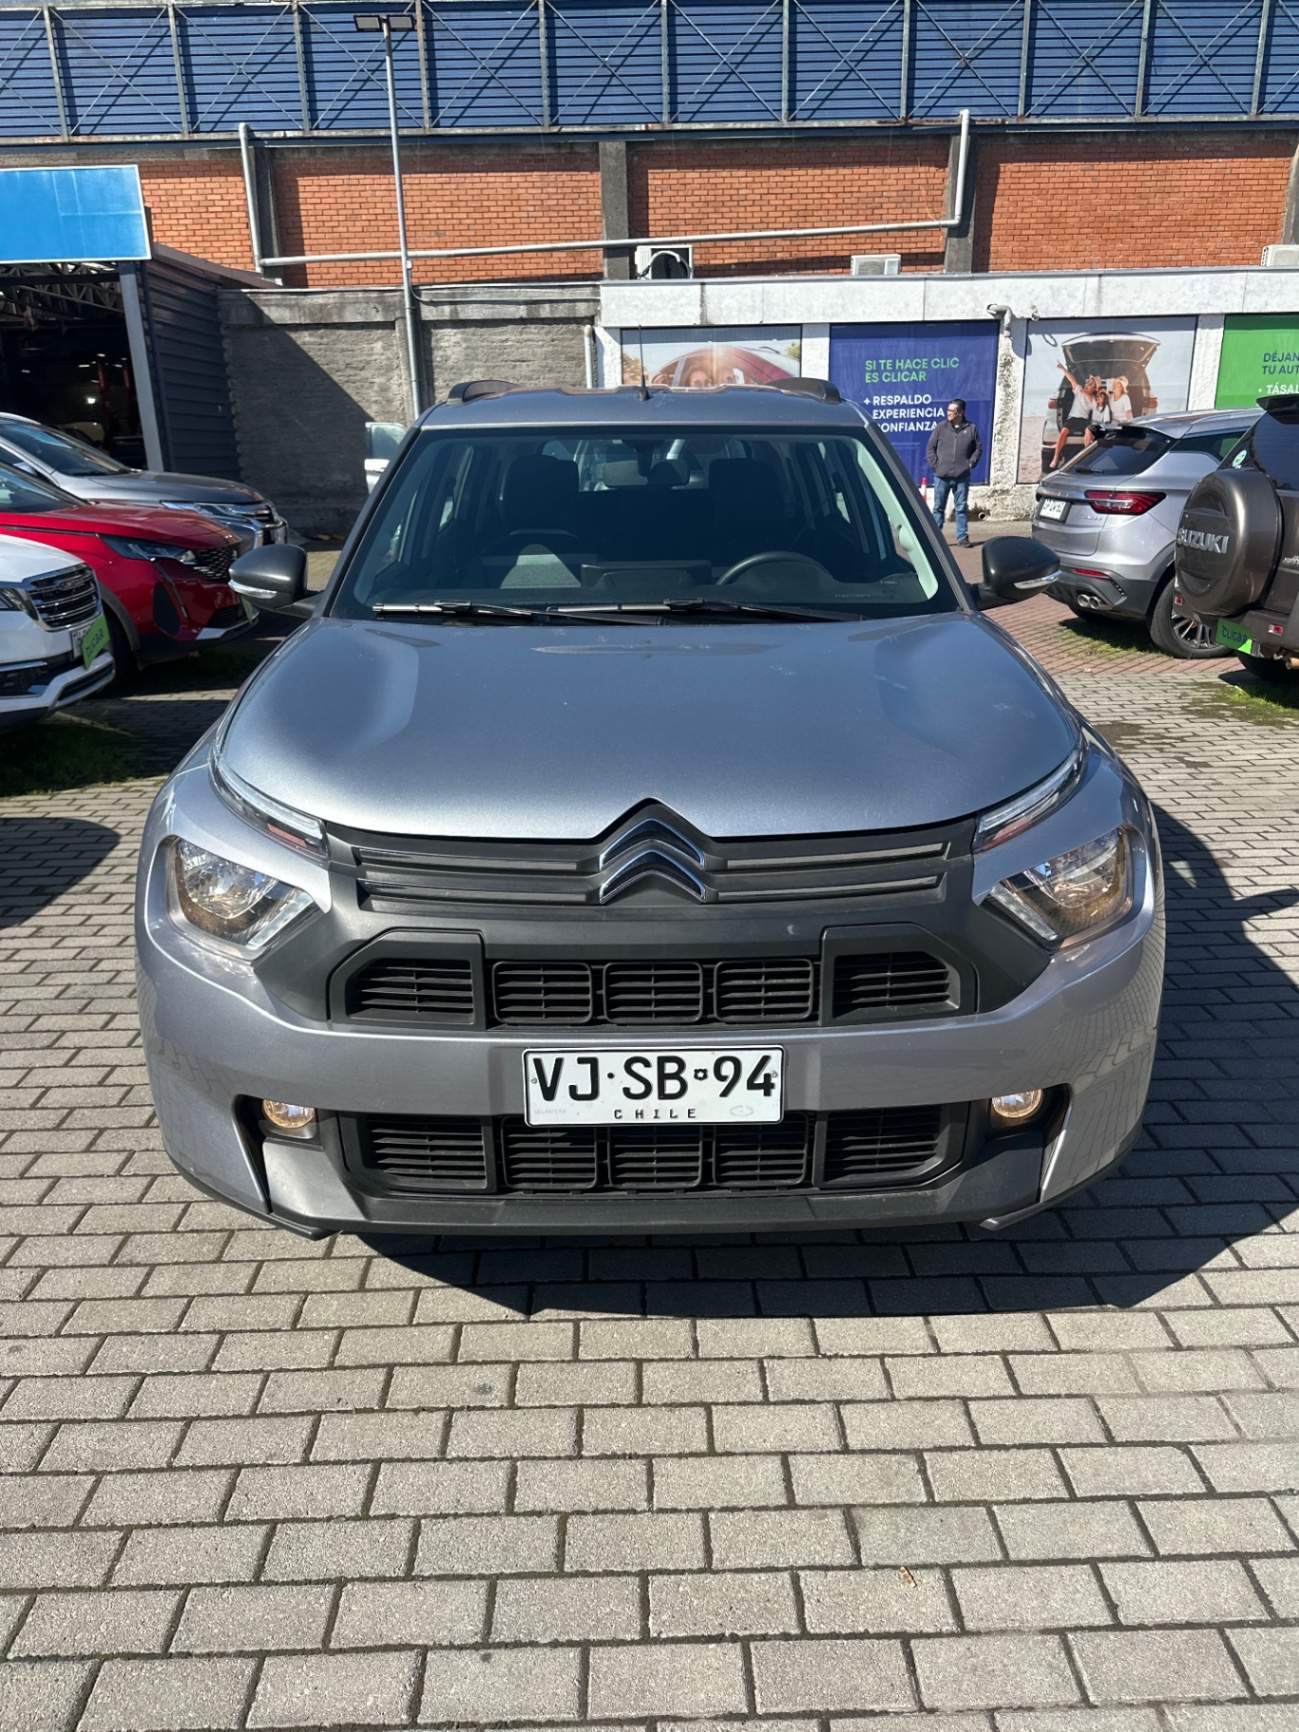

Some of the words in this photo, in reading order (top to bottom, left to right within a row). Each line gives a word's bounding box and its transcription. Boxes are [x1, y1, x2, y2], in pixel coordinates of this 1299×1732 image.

[865, 360, 876, 371] SI
[879, 360, 893, 370] TE
[895, 358, 929, 369] HACE
[931, 357, 960, 368] CLIC
[1262, 365, 1277, 375] TU
[865, 372, 879, 383] ES
[882, 371, 927, 382] CLICAR
[872, 394, 932, 406] RESPALDO
[872, 407, 945, 420] EXPERIENCIA
[879, 421, 937, 433] ONFIANZA
[1177, 527, 1229, 554] SUZUKI
[613, 1108, 697, 1119] CHILE
